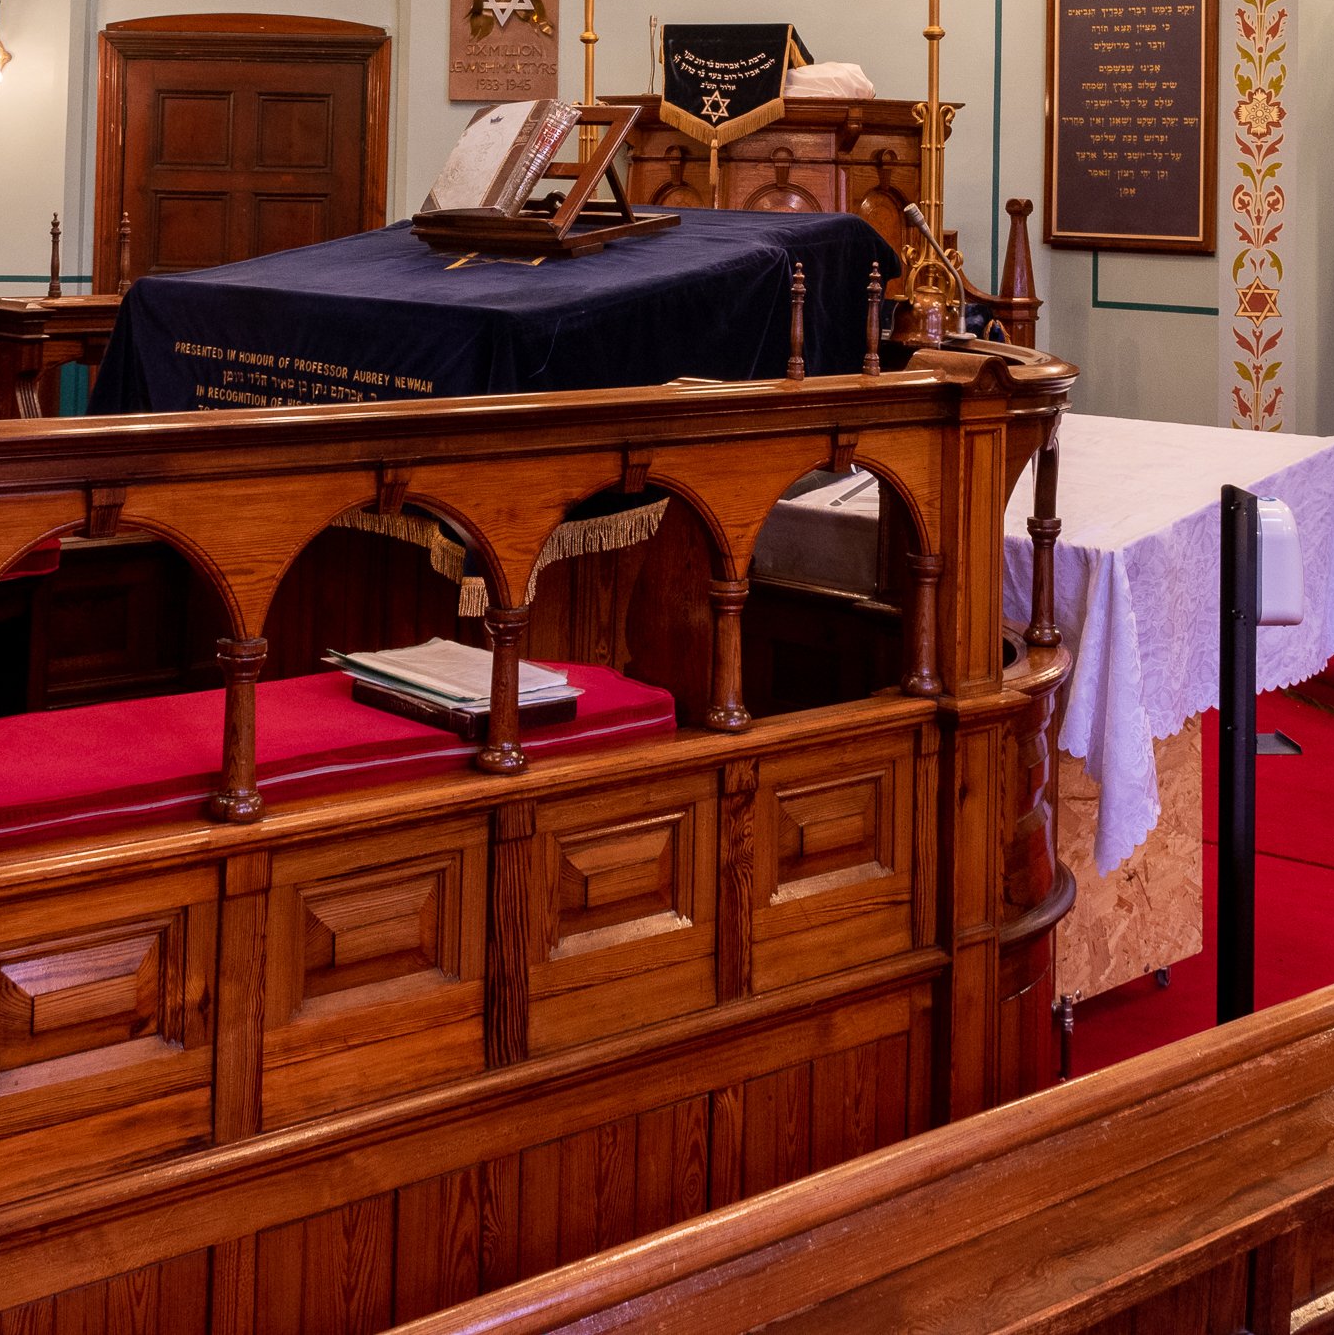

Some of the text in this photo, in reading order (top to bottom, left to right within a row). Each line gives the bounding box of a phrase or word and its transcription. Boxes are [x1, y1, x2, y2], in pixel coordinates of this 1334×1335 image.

[466, 44, 542, 57] SIX MILLION
[449, 62, 557, 75] JEWISH MARTYRS
[475, 78, 532, 91] 1933-1945
[175, 341, 433, 393] PRESENTED IN HONOUR OF PROFESSOR AUBREY NEWMAN
[196, 384, 205, 397] IN
[208, 386, 267, 406] RECOGNITION
[270, 397, 283, 407] OF
